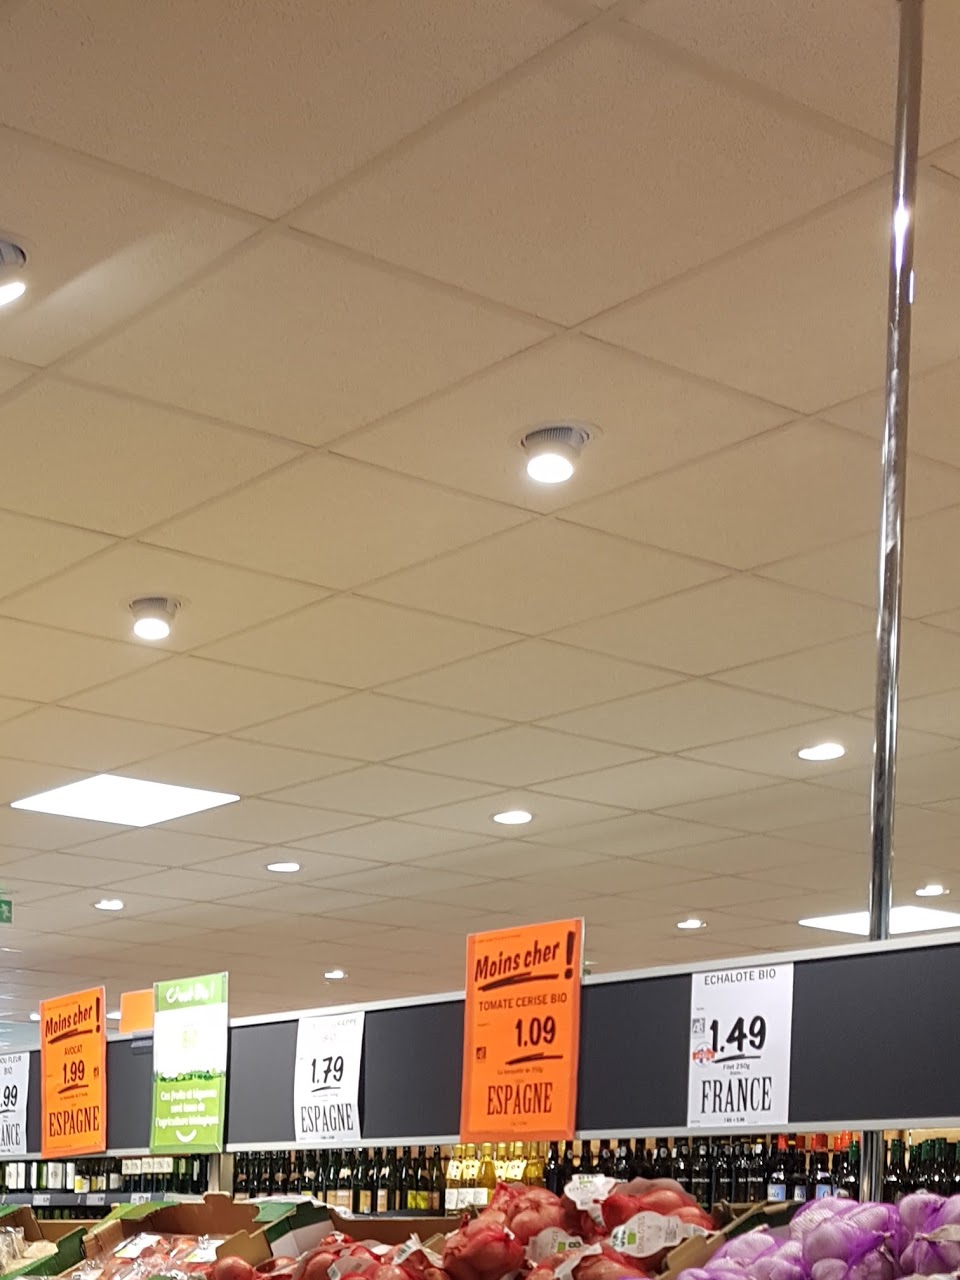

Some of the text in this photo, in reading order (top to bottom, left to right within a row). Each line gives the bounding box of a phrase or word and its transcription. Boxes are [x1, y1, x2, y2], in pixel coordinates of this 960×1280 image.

[474, 952, 521, 982] Moins
[524, 940, 560, 968] cher
[704, 968, 776, 986] ECHALOTE BIO
[479, 992, 568, 1012] TOMATE CERISE BIO
[45, 1014, 71, 1037] Moins
[73, 1004, 93, 1025] cher
[515, 1016, 556, 1047] 1.09
[709, 1015, 767, 1053] 1.49
[64, 1044, 83, 1056] AVOCAT
[63, 1060, 85, 1084] 1.99
[311, 1056, 344, 1083] 1.79
[487, 1082, 553, 1116] ESPAGNE
[701, 1076, 772, 1114] FRANCE
[49, 1105, 100, 1137] ESPAGNE
[301, 1103, 353, 1133] ESPAGNE
